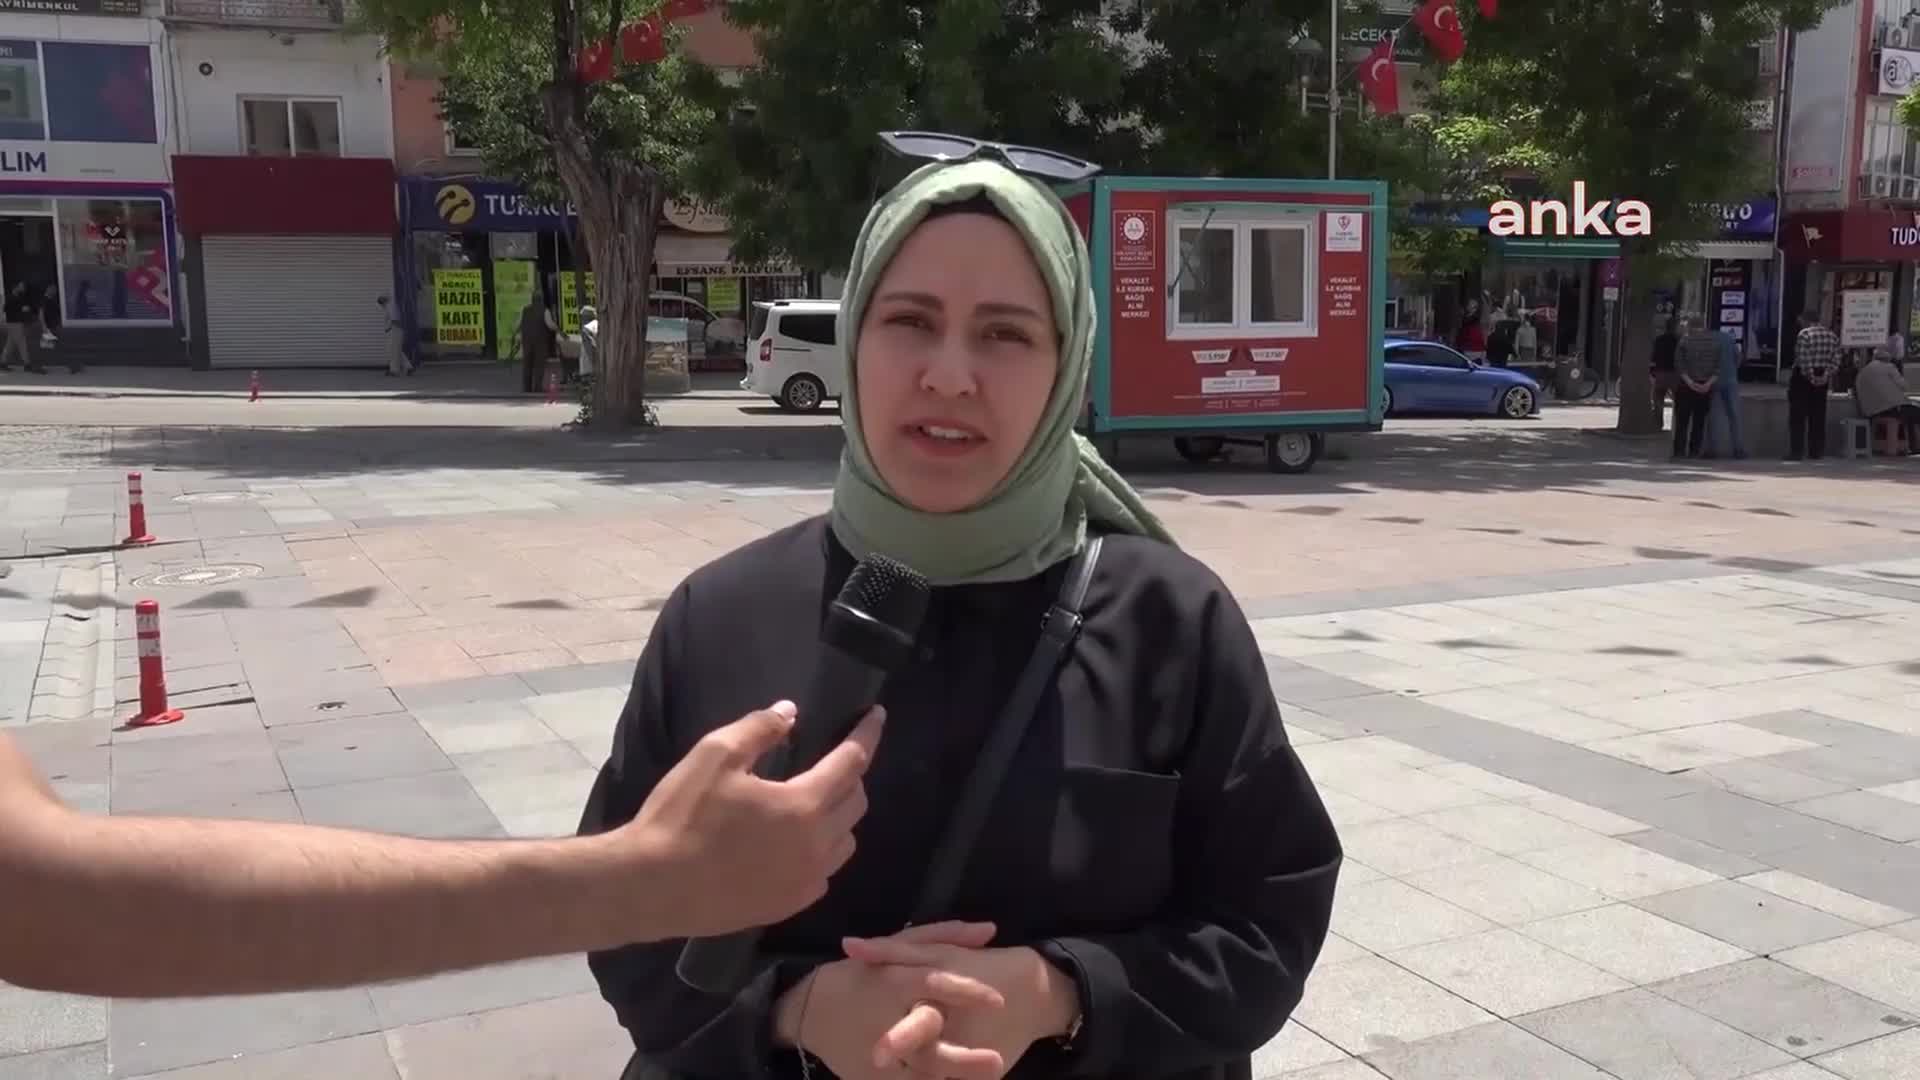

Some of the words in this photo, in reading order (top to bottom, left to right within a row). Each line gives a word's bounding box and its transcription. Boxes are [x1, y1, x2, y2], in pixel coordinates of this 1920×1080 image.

[1891, 227, 1920, 245] TUD
[439, 292, 481, 305] HAZIR
[442, 312, 479, 325] KART
